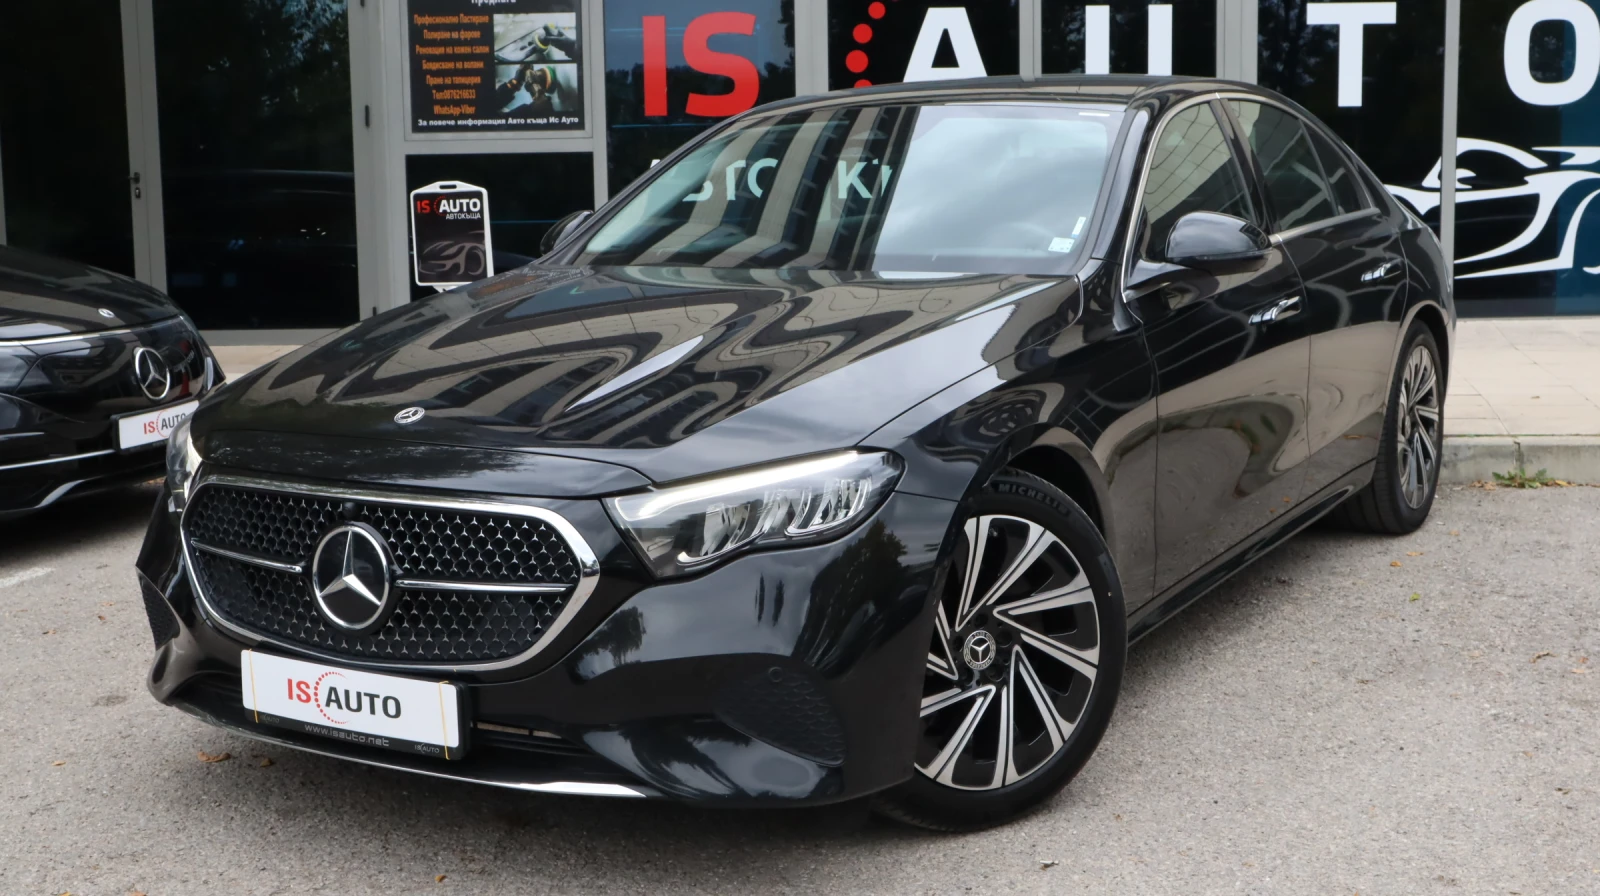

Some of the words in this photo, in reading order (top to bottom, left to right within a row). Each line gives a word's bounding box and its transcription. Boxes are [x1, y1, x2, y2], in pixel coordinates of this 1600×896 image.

[451, 31, 459, 39] на
[445, 46, 453, 54] на
[456, 61, 463, 69] на
[642, 11, 760, 116] IS
[444, 76, 452, 84] на
[457, 117, 505, 127] информация
[507, 117, 525, 125] Авто
[526, 117, 547, 125] къща
[549, 116, 559, 124] Ис
[561, 116, 579, 124] Ауто
[416, 200, 431, 214] IS
[439, 198, 481, 213] AUTO
[446, 212, 481, 220] АВТОКЪЩА
[143, 421, 156, 435] IS
[287, 678, 312, 703] IS
[325, 686, 402, 719] AUTO
[304, 723, 391, 747] www.isauto.net
[422, 745, 440, 754] AUTO
